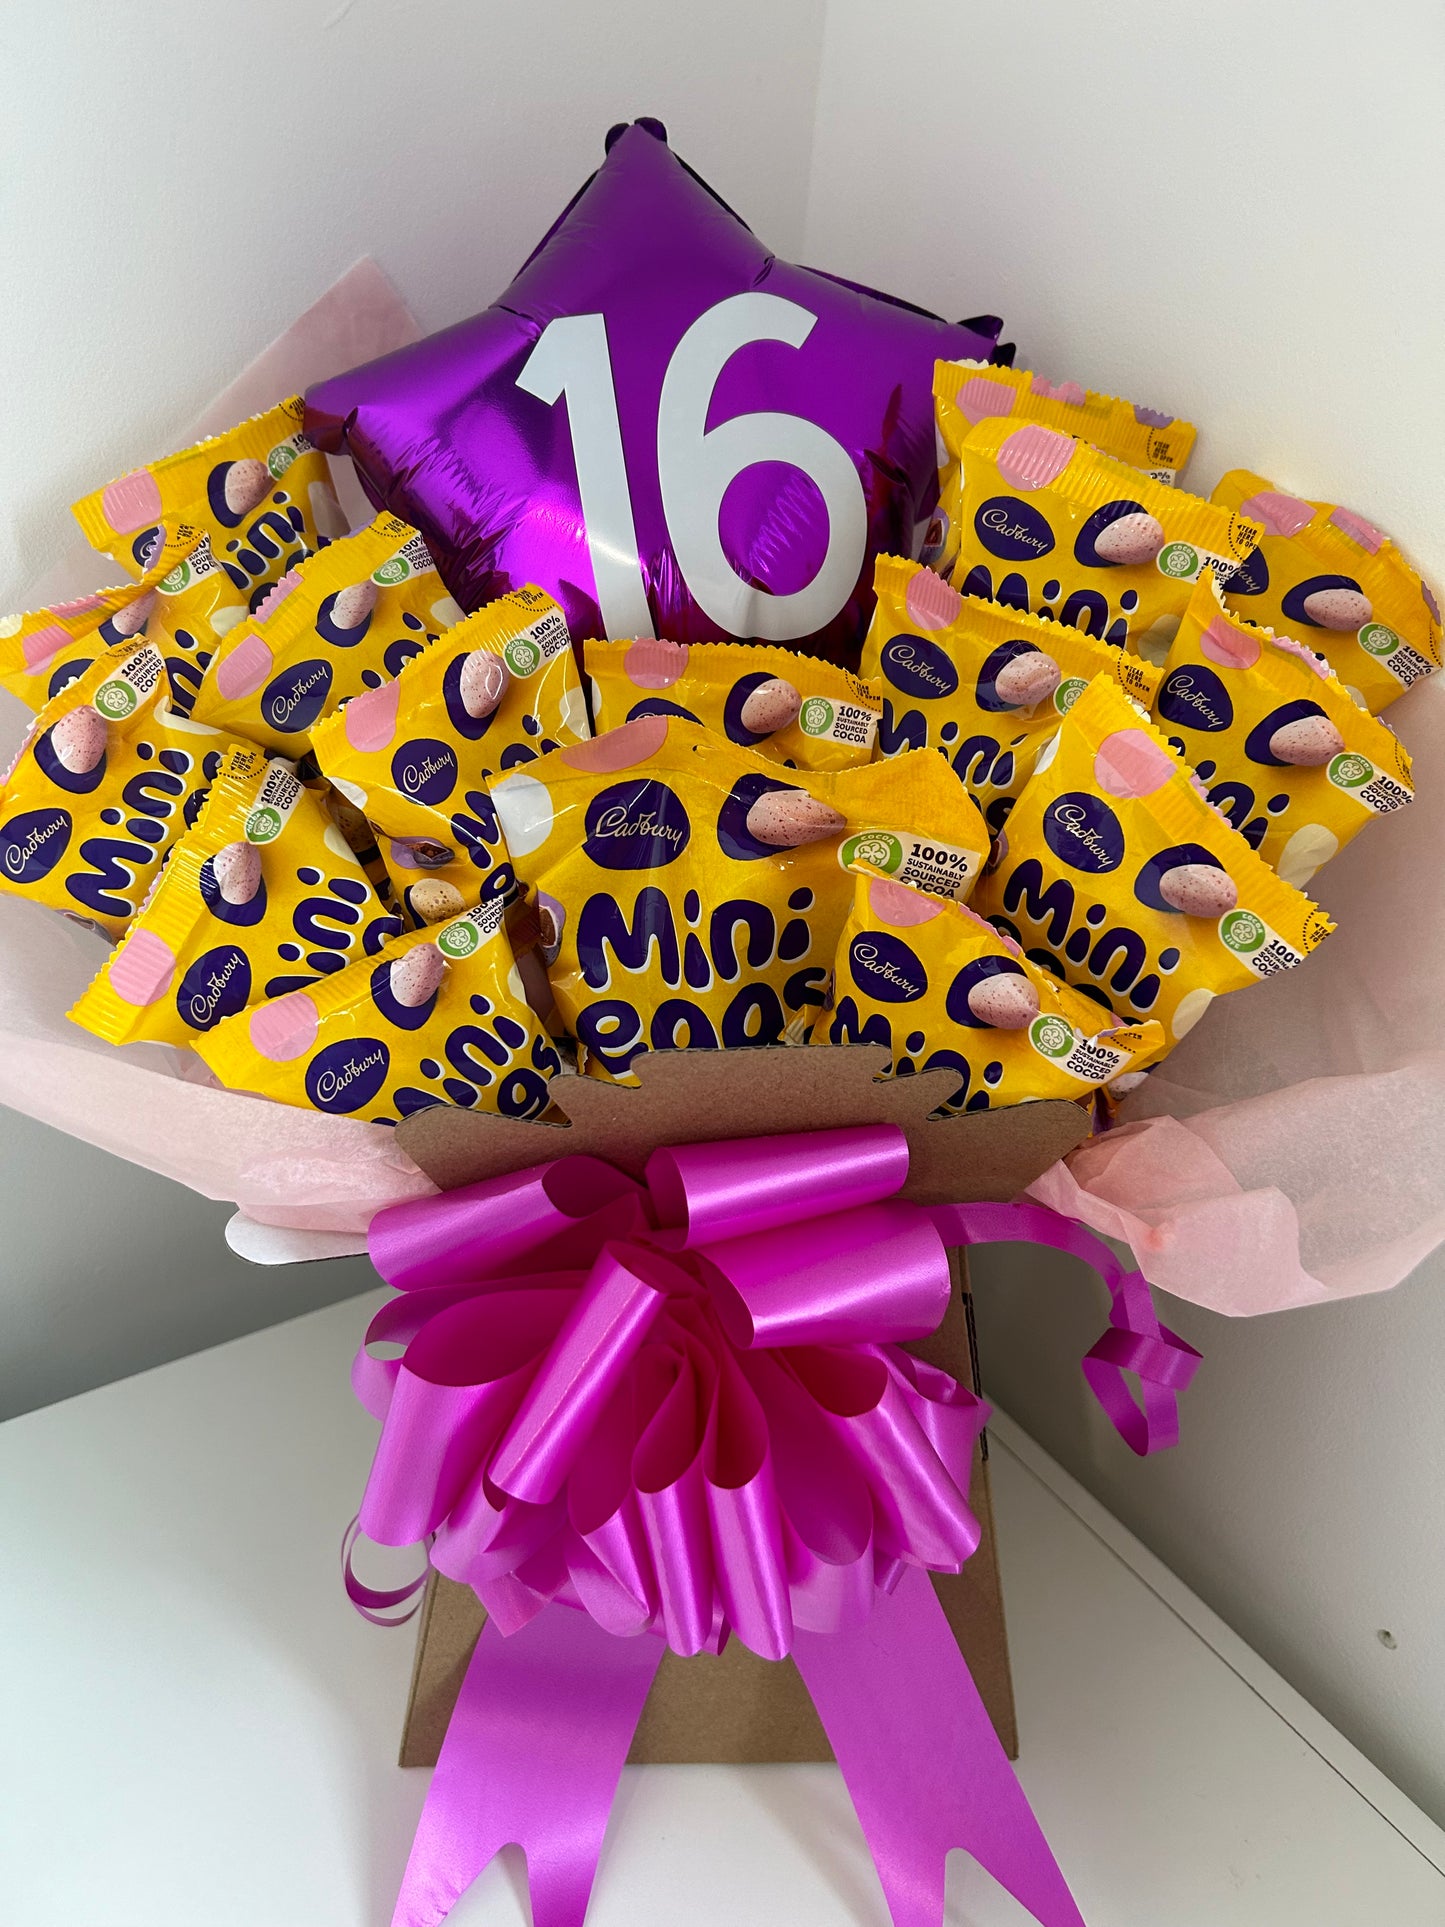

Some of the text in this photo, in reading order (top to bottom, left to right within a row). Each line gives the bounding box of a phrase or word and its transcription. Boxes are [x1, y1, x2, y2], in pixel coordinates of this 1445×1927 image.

[515, 291, 867, 642] 16
[981, 509, 1048, 554] Cadbury
[1172, 545, 1195, 559] COCOA
[1165, 568, 1181, 577] LIFE
[530, 615, 561, 640] 100%
[541, 627, 568, 651] SOURCED
[544, 635, 571, 658] COCOA
[121, 649, 153, 677] 100%
[888, 644, 951, 694] Cadbury
[1403, 645, 1434, 674] 100%
[134, 658, 163, 688] SOURCED
[97, 682, 116, 701] COCOA
[271, 665, 329, 725] Cadbury
[1167, 674, 1224, 728] Cadbury
[120, 702, 136, 716] LIFE
[809, 700, 830, 710] COCOA
[839, 705, 872, 722] 100%
[805, 726, 820, 734] LIFE
[834, 722, 868, 735] SOURCED
[837, 717, 869, 727] SUSTAINABLY
[833, 730, 866, 744] COCOA
[403, 752, 454, 794] Cadbury
[1332, 773, 1348, 786] LIFE
[260, 769, 283, 804] 100%
[281, 781, 302, 811] COCOA
[1366, 785, 1399, 810] SOURCED
[1377, 775, 1413, 804] 100%
[65, 741, 194, 918] Mini
[268, 822, 280, 838] LIFE
[596, 805, 683, 851] Cadbury
[860, 833, 895, 847] COCOA
[1054, 804, 1114, 869] Cadbury
[5, 815, 69, 875] Cadbury
[906, 858, 965, 881] SUSTAINABLY
[910, 843, 968, 873] 100%
[903, 867, 961, 889] SOURCED
[1003, 858, 1181, 1013] Mini
[1242, 913, 1263, 934] COCOA
[460, 942, 476, 955] LIFE
[576, 886, 816, 994] Mini
[1224, 934, 1241, 950] LIFE
[853, 943, 920, 998] Cadbury
[1252, 957, 1277, 977] COC
[190, 953, 245, 1025] Cadbury
[1036, 1042, 1054, 1056] LIFE
[1075, 1048, 1116, 1069] SUSTAINABLY
[1079, 1039, 1120, 1064] 100%
[317, 1050, 385, 1102] Cadbury
[1066, 1060, 1106, 1081] COCOA
[1070, 1053, 1111, 1075] SOURCED
